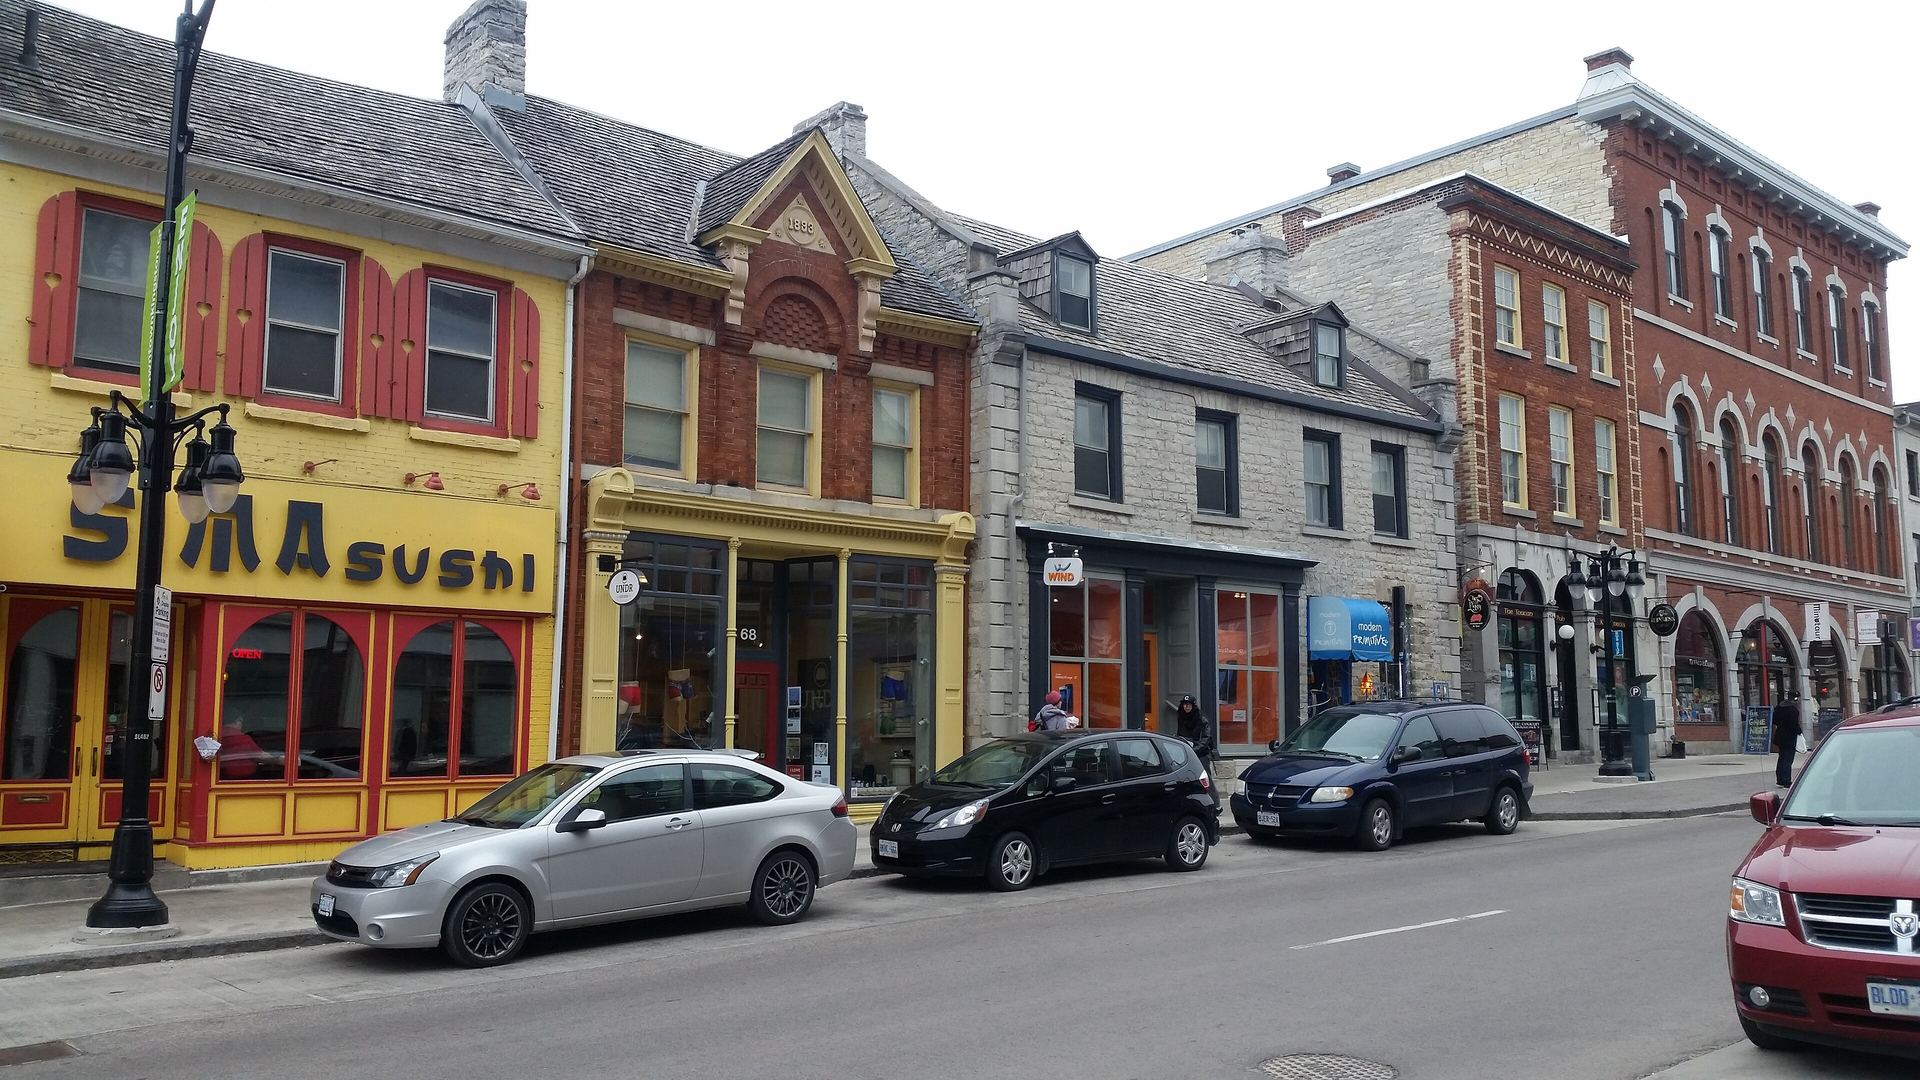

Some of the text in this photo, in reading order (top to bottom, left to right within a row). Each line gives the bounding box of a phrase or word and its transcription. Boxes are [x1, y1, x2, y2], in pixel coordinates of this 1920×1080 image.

[788, 217, 814, 234] 1893
[168, 204, 189, 383] ENJOY
[63, 487, 331, 578] SMA
[1048, 572, 1075, 582] WIND
[615, 583, 634, 594] UNDR
[740, 628, 757, 641] 68
[232, 648, 262, 659] OPEN
